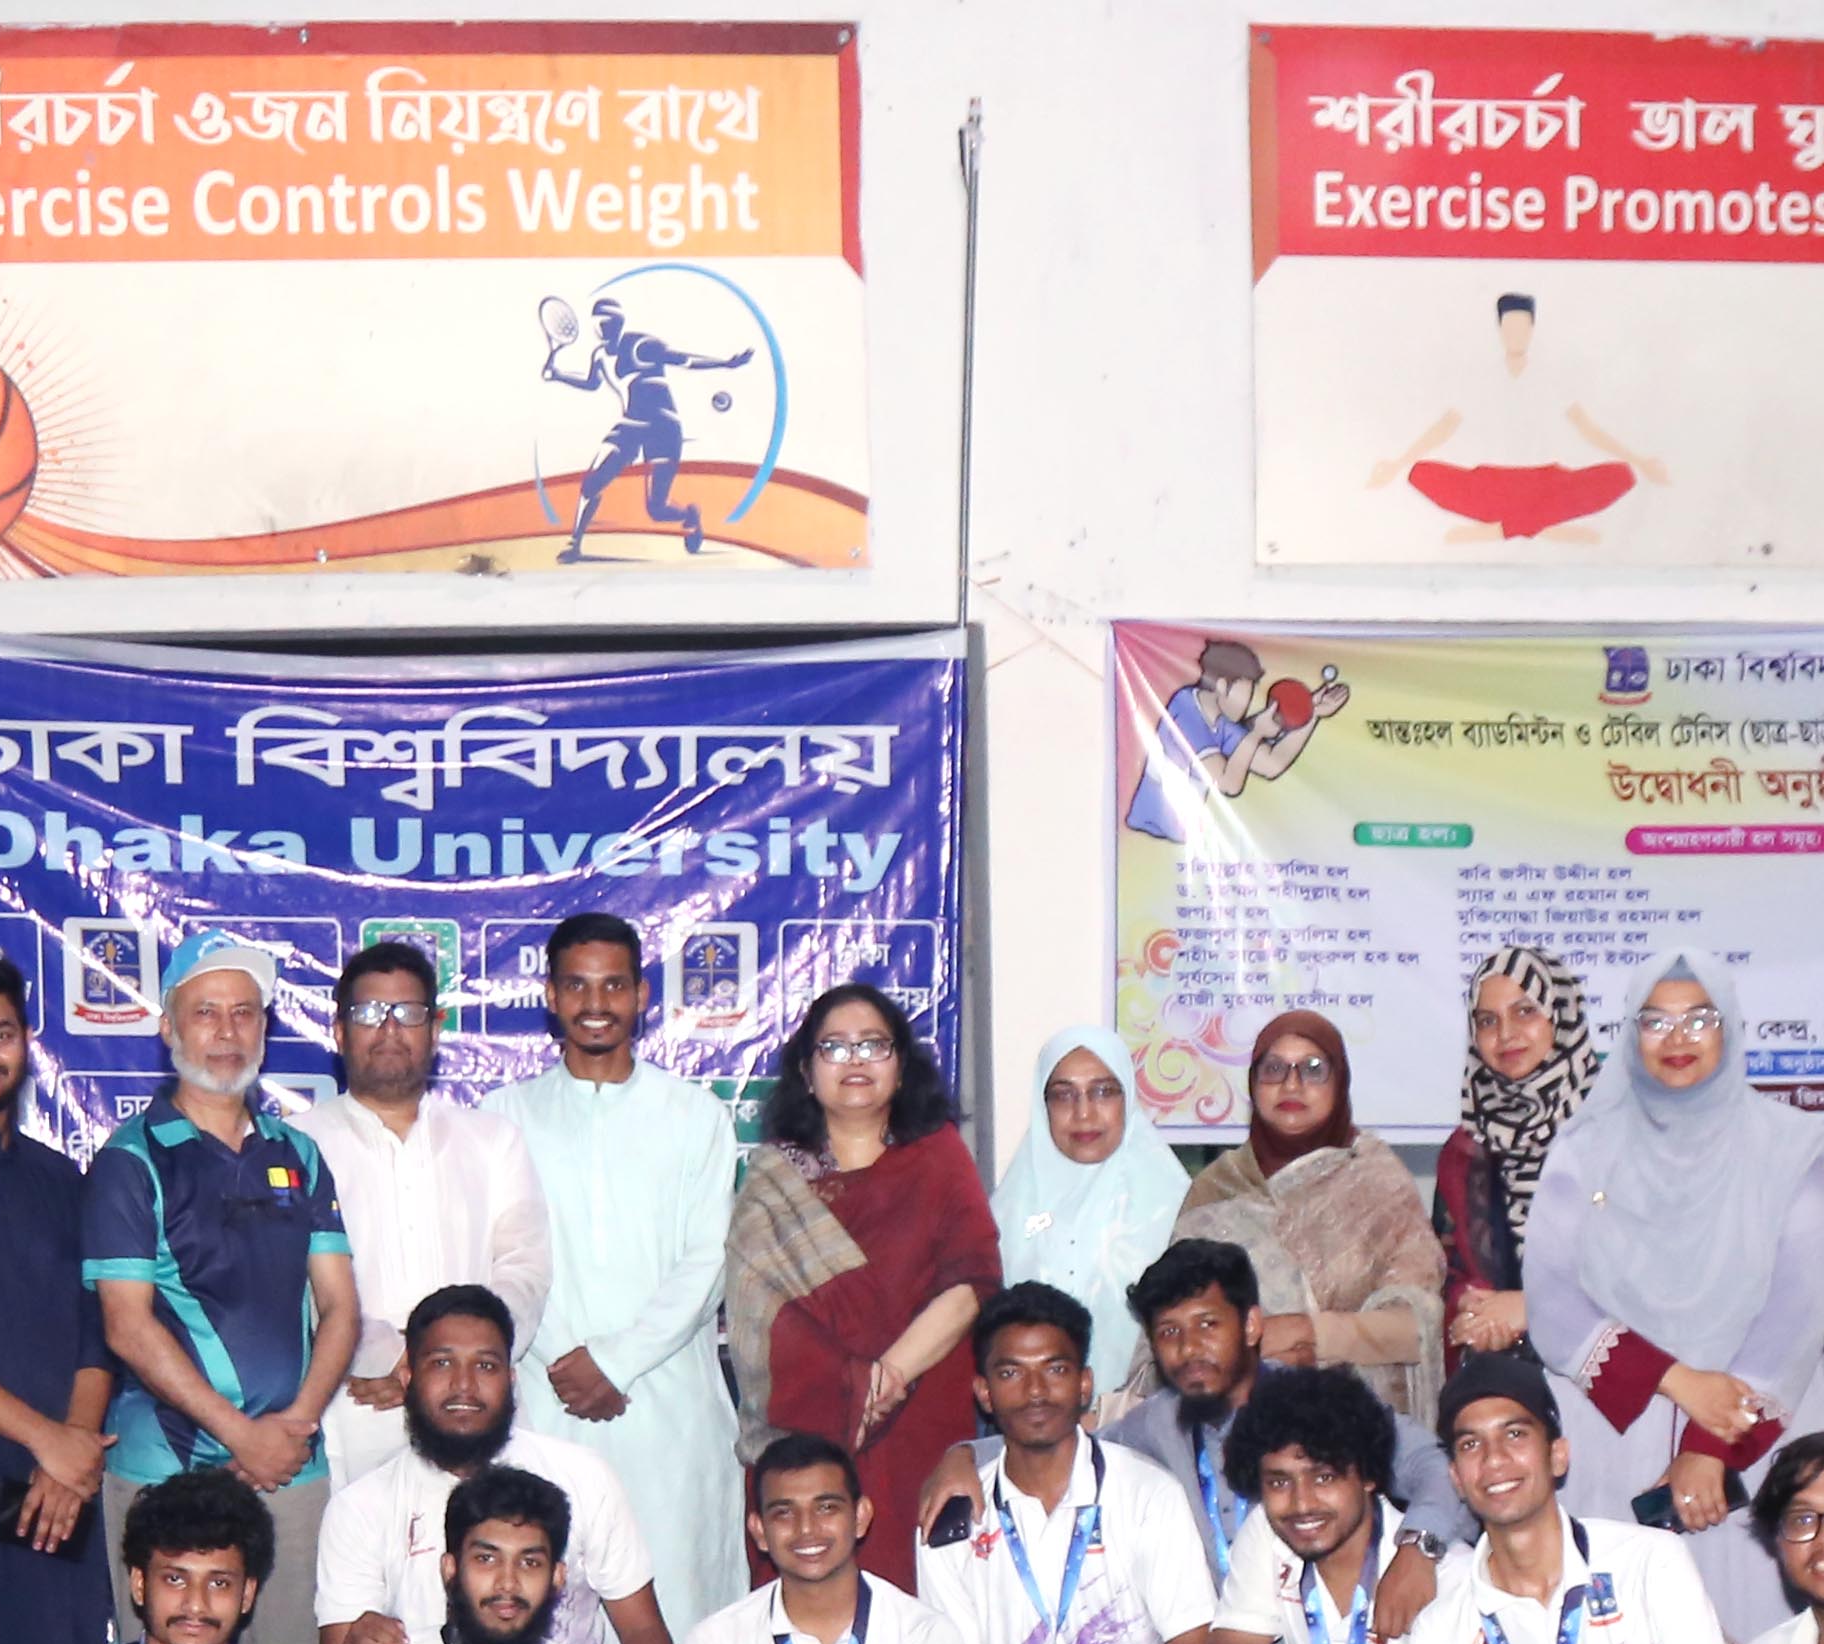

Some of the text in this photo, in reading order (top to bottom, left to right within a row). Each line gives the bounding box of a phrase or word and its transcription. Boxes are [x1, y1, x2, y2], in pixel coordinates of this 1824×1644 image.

[173, 89, 350, 155] ওজন
[364, 66, 604, 156] নিয়ন্ত্রণে
[616, 85, 762, 155] রাখে
[1307, 69, 1587, 151] শরীরচর্চা
[1629, 97, 1758, 153] ভাল
[192, 165, 488, 236] Controls
[506, 163, 761, 249] Weight
[1313, 170, 1546, 231] Exercise
[1666, 657, 1725, 683] ঢাকা
[225, 705, 899, 810] বিশ্ববিদ্যালয়
[1365, 718, 1453, 748] আন্তঃহল
[1461, 712, 1566, 749] ব্যাডমিন্টন
[1575, 725, 1592, 747] ও
[1601, 712, 1661, 748] টেবিল
[1671, 712, 1731, 748] টেনিস
[1606, 757, 1745, 804] উদ্বোধনী
[351, 817, 901, 893] University
